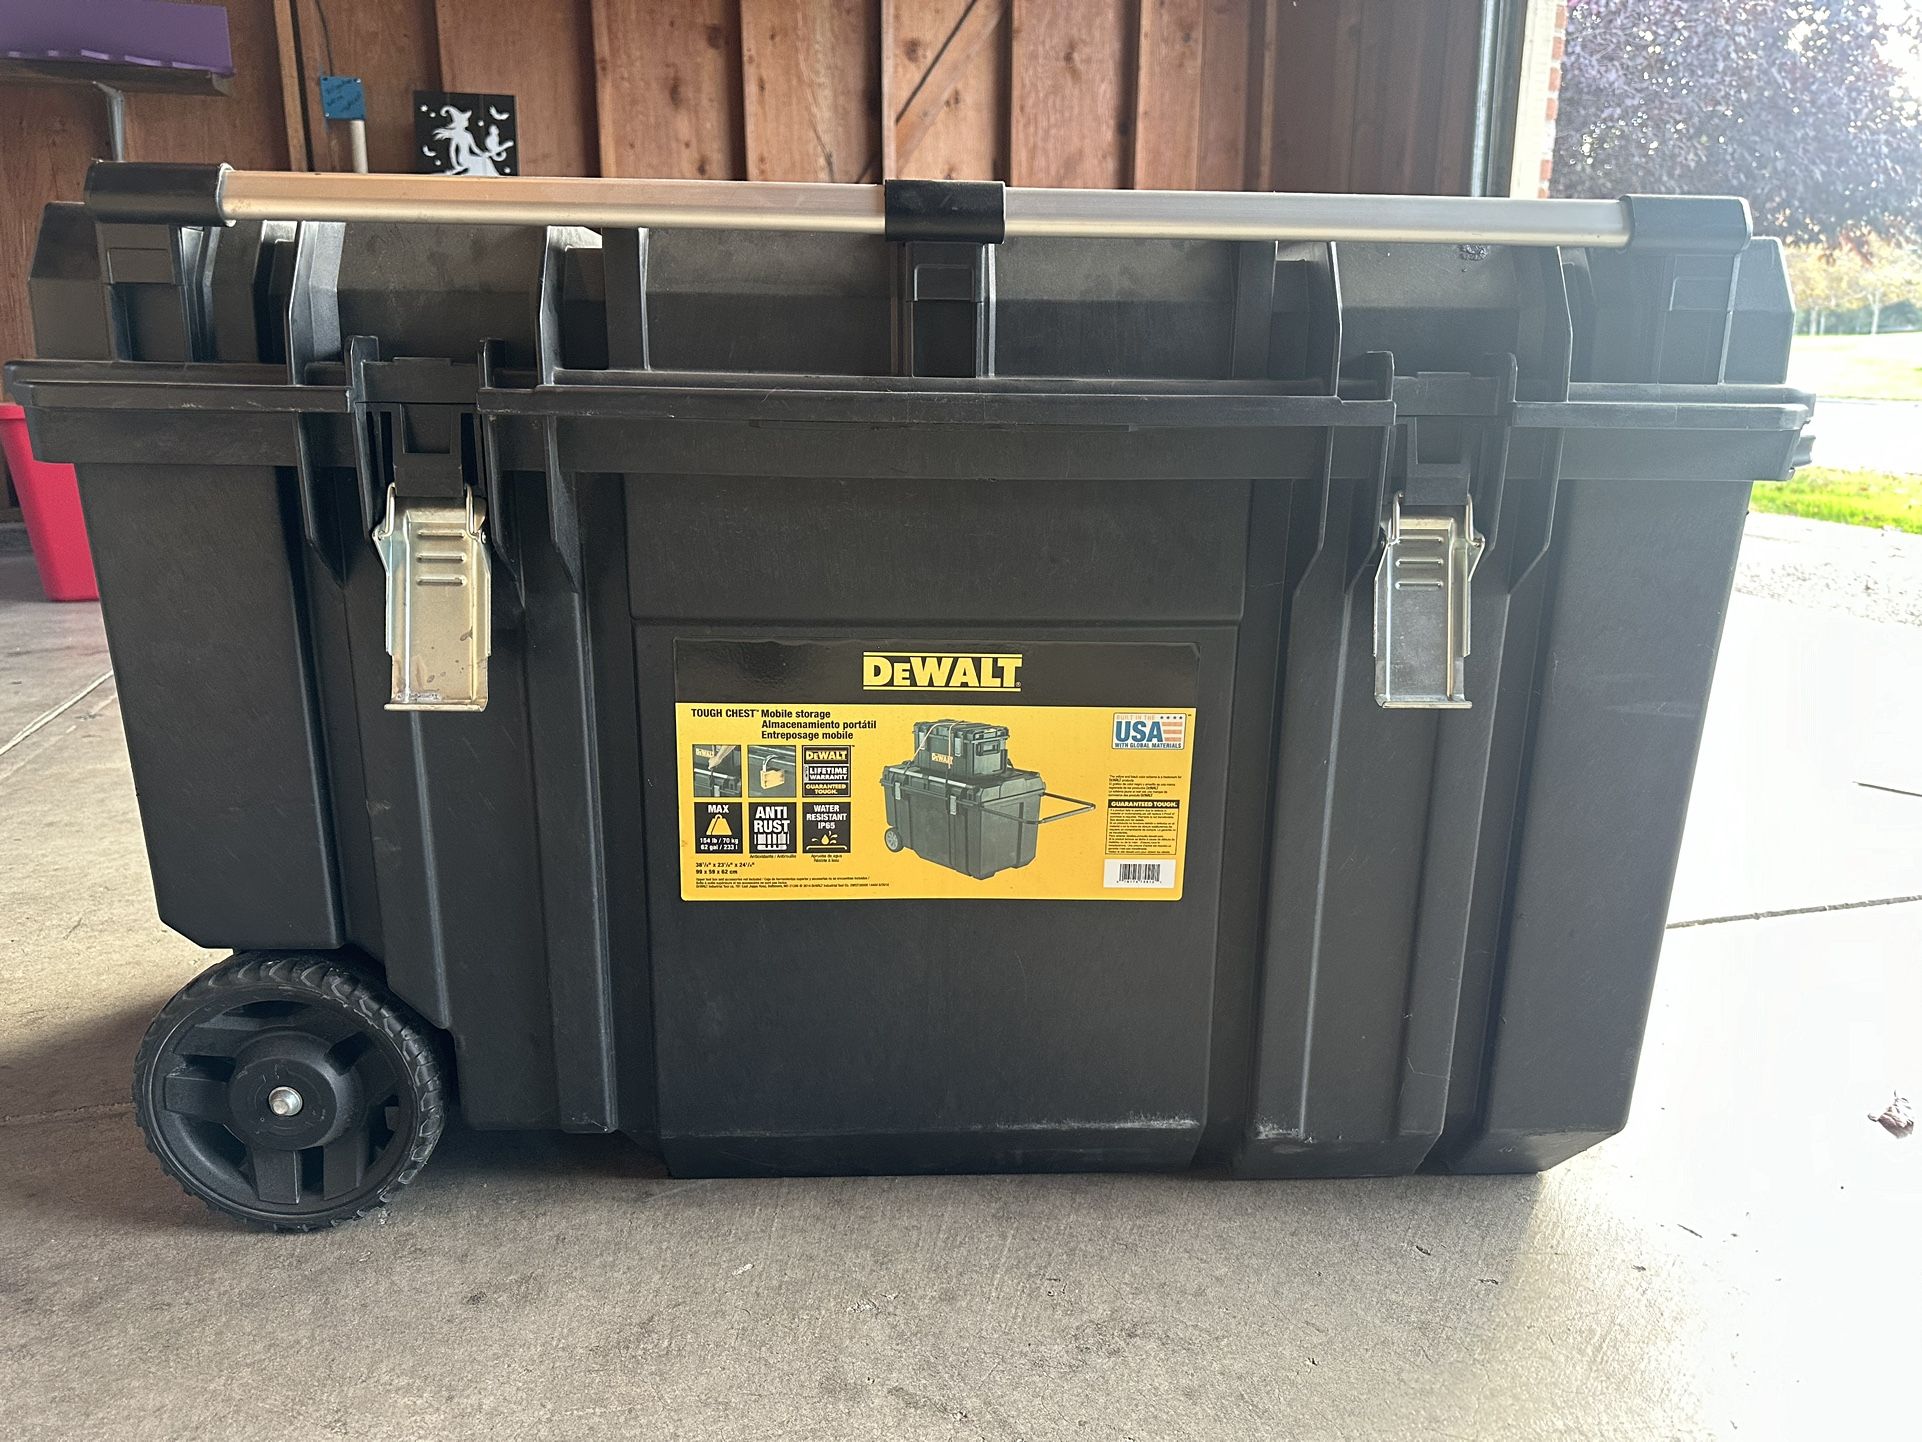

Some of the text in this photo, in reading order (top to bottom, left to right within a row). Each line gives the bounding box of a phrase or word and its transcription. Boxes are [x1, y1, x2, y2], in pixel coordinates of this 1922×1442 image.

[863, 656, 1022, 687] DEWALT
[692, 708, 722, 718] TOUGH
[761, 709, 793, 718] Mobile
[796, 710, 830, 720] storage
[761, 720, 876, 730] Almacenamiento portátil
[1116, 720, 1163, 742] USA
[761, 731, 853, 741] Entreposage mobile
[806, 750, 847, 760] DEWALT
[708, 805, 729, 813] MAX
[756, 806, 787, 818] ANTI
[754, 820, 790, 833] RUST
